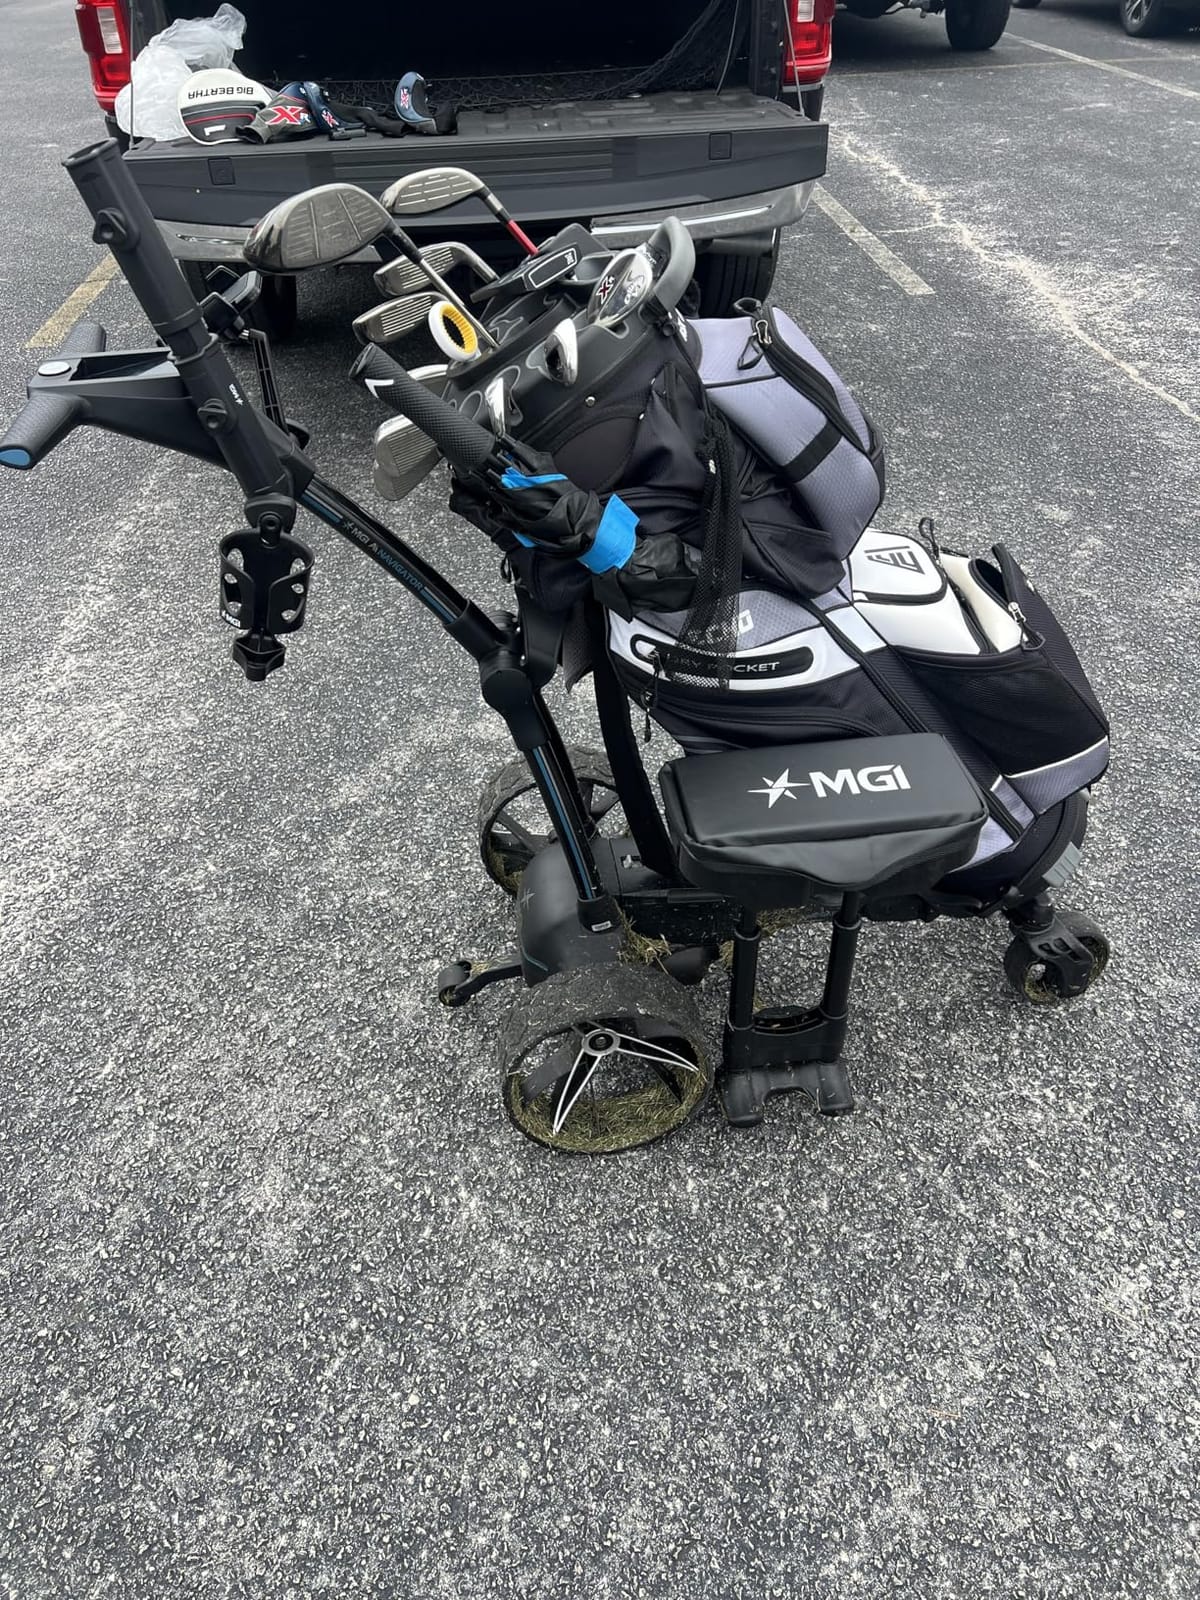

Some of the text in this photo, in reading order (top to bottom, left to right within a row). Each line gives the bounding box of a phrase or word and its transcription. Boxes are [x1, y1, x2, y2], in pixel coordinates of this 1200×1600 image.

[187, 86, 254, 100] BIG BERTHA
[351, 527, 371, 544] MGI
[377, 549, 423, 591] NAVIGATOR
[808, 764, 912, 798] MGI
